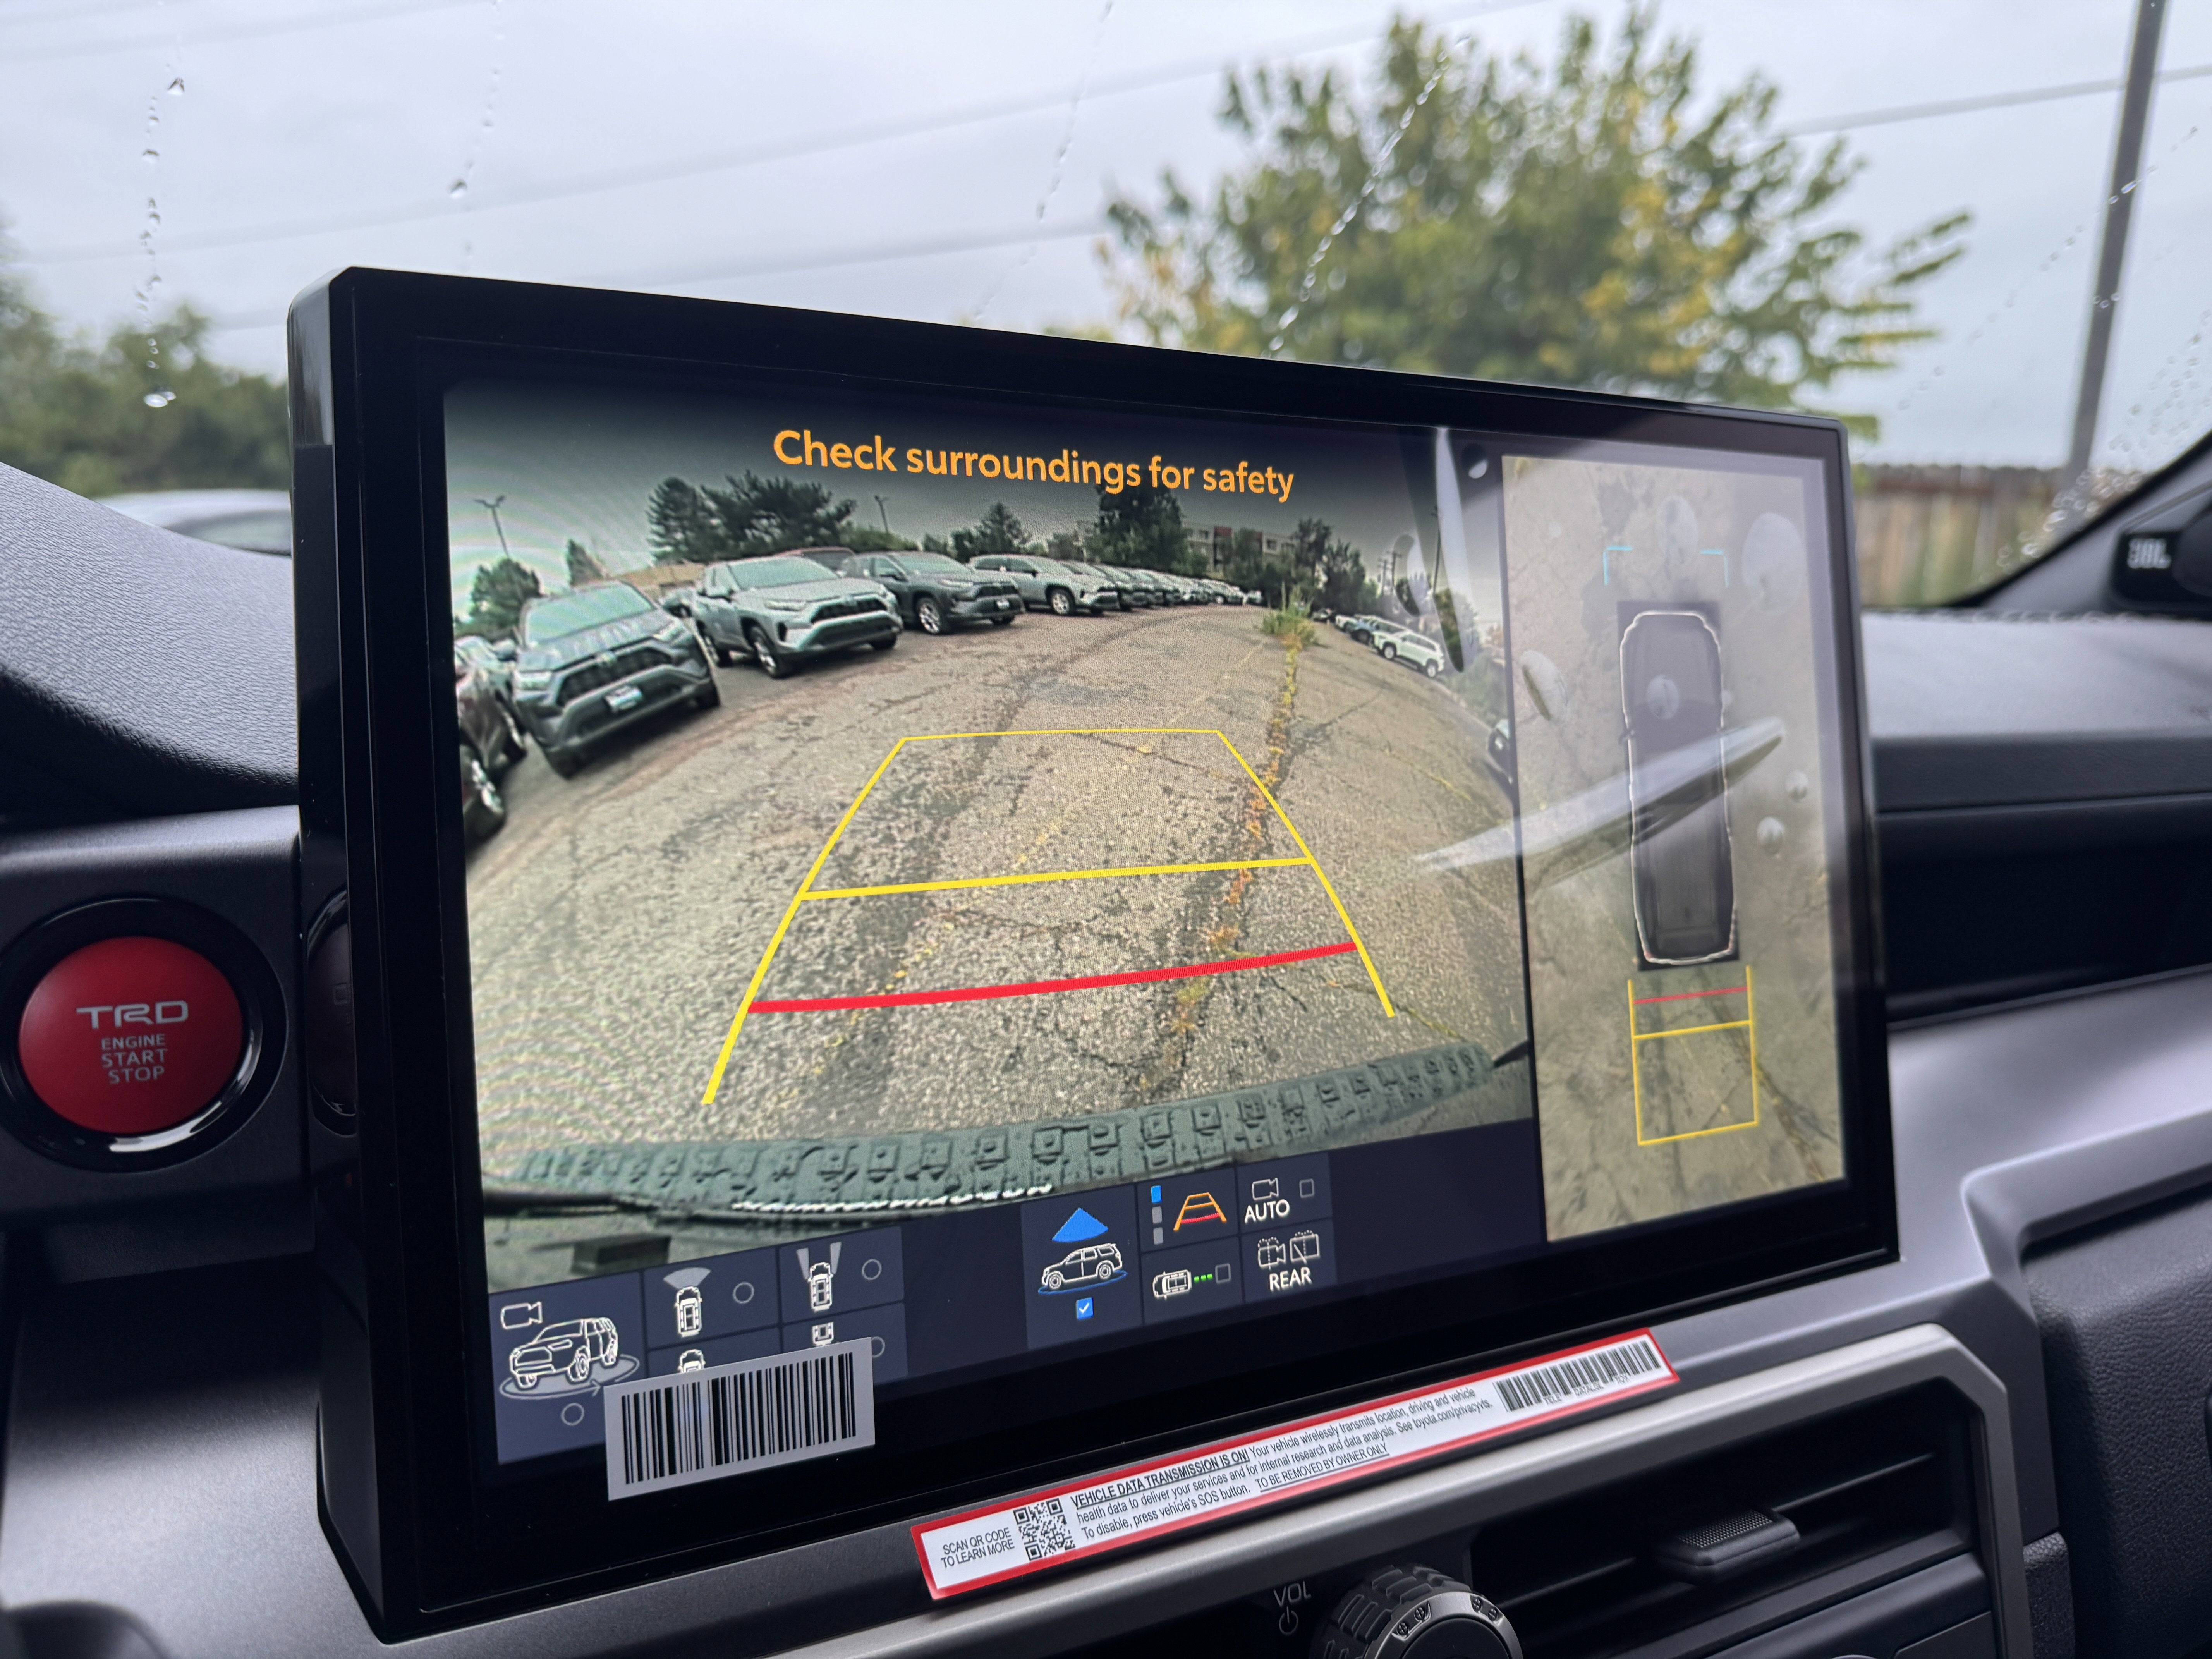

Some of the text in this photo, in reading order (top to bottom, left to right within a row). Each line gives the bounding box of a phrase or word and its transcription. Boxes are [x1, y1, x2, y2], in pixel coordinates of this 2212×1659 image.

[773, 429, 1295, 503] Check surroundings for safety
[76, 1000, 188, 1029] TRD
[101, 1034, 166, 1050] ENGINE
[101, 1049, 168, 1068] START
[109, 1065, 165, 1084] STOP
[1244, 1199, 1290, 1224] AUTO
[1269, 1267, 1312, 1292] REAR
[1071, 1387, 1476, 1508] VEHICLE DATA TRANSMISSION IS ON! Your vehicle wirelessly transmits location, driving and vehicle
[1077, 1506, 1106, 1525] health
[1107, 1500, 1128, 1515] data
[1128, 1498, 1139, 1509] to
[1141, 1489, 1170, 1505] deliver
[1171, 1483, 1192, 1500] your
[1193, 1473, 1228, 1491] services
[1230, 1467, 1246, 1481] and
[1246, 1463, 1259, 1476] for
[1259, 1453, 1291, 1472] internal
[1291, 1445, 1326, 1462] research
[1327, 1438, 1343, 1452] and
[1344, 1432, 1362, 1447] data
[1363, 1425, 1397, 1443] analysis.
[1396, 1421, 1413, 1433] See
[1255, 1442, 1388, 1490] TO BE REMOVED BY OWNER ONLY
[1082, 1484, 1250, 1539] To disable, press vehicle's SOS button.
[941, 1538, 1015, 1568] TO LEARN MORE
[943, 1527, 1012, 1555] SCAN QR CODE
[1273, 1580, 1312, 1606] VOL
